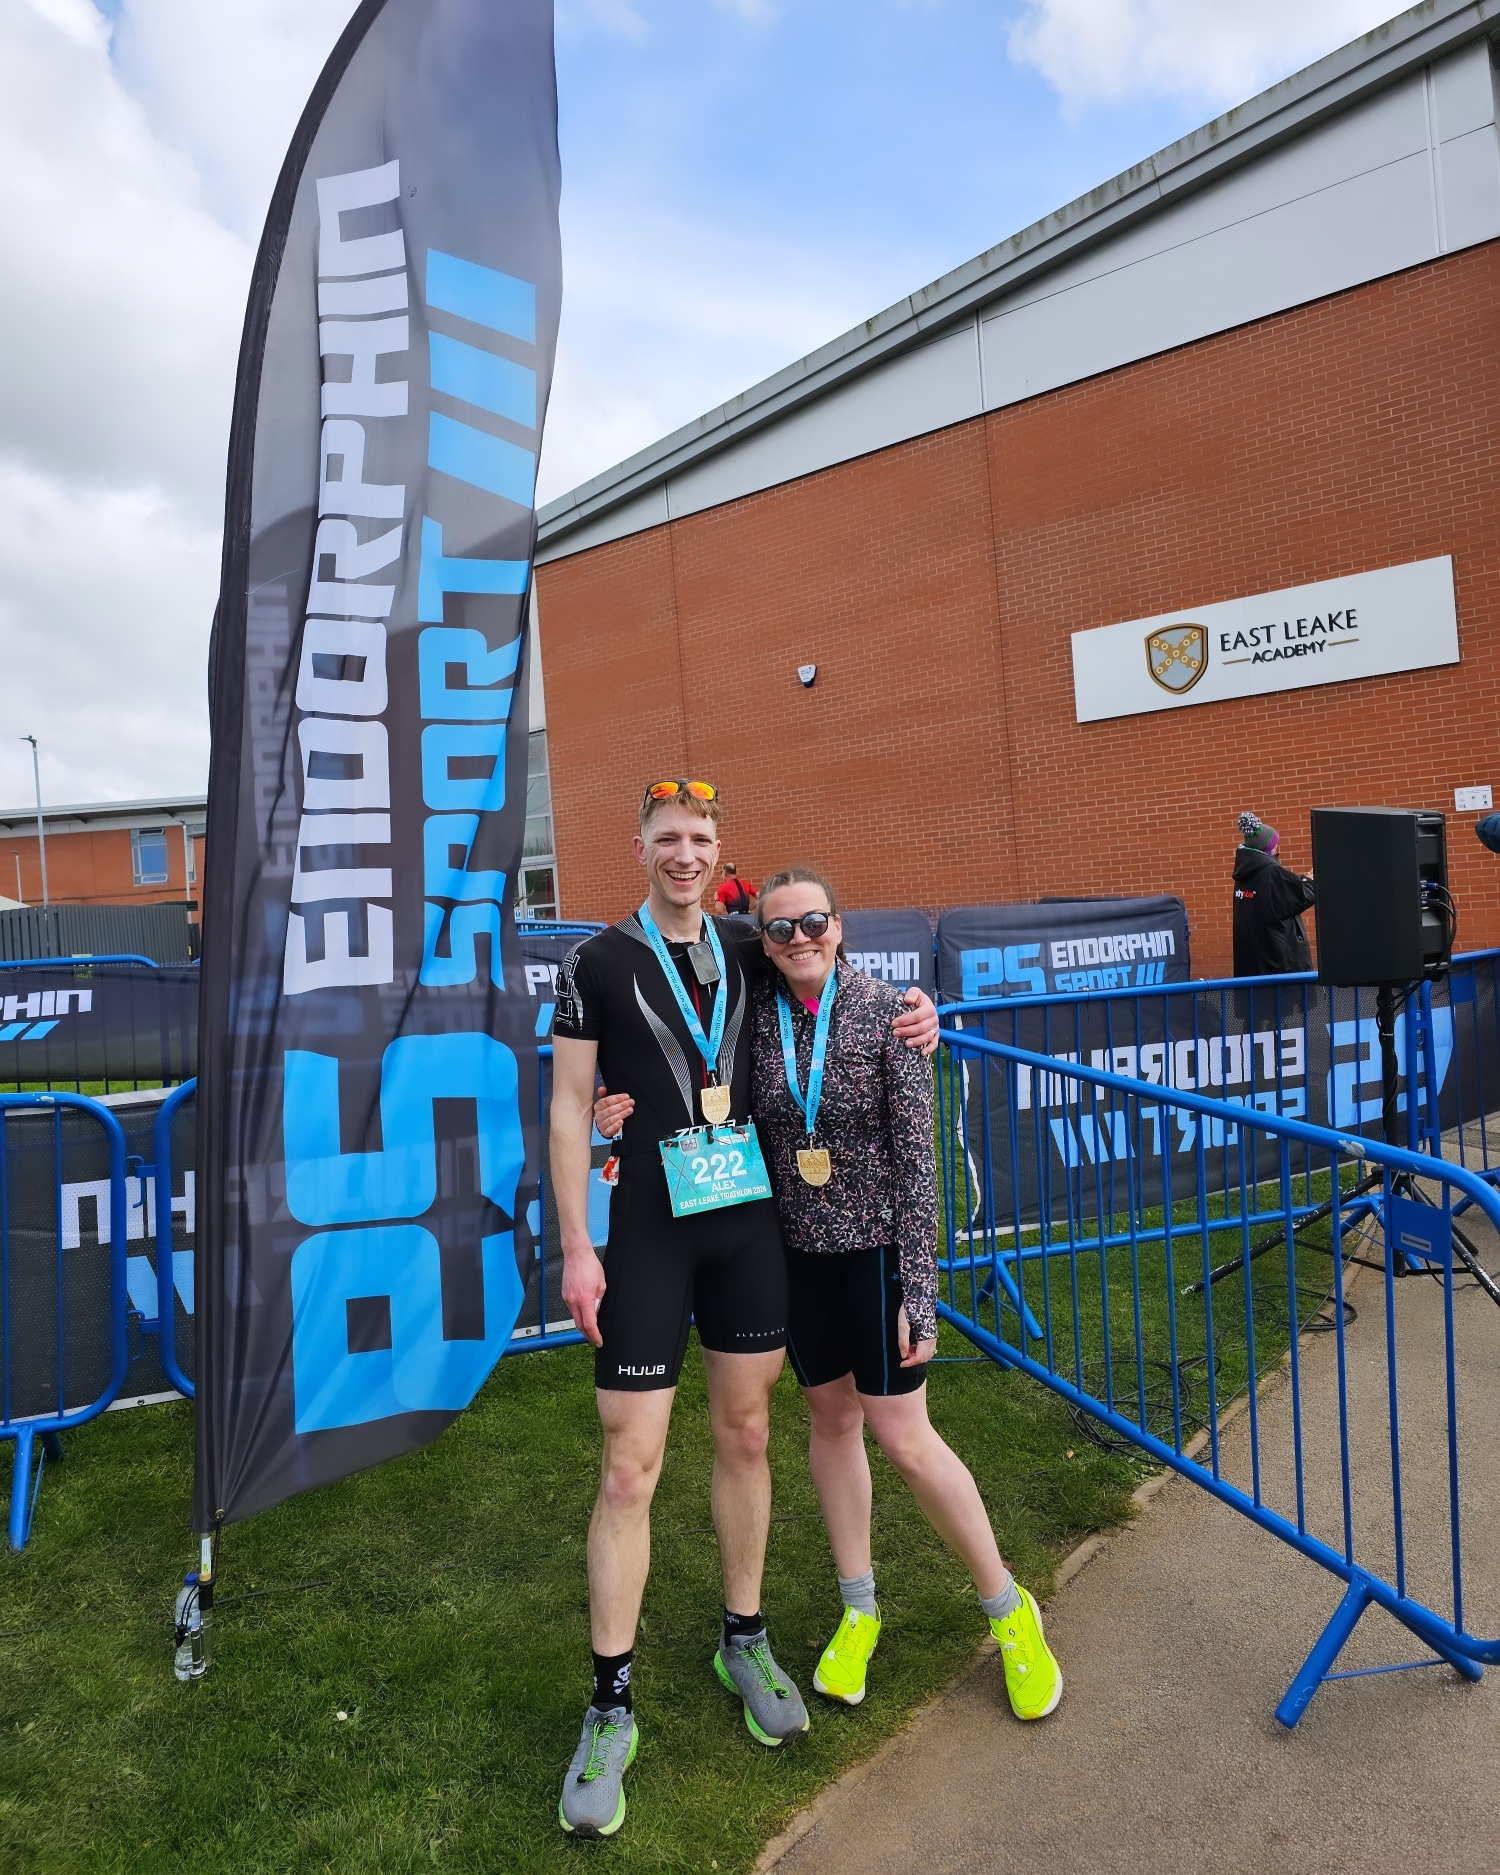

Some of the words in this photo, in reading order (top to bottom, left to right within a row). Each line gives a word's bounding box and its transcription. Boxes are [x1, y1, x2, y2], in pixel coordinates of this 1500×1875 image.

[283, 159, 409, 995] ENDORPHIN
[1220, 624, 1276, 651] EAST
[1284, 608, 1358, 640] LEAKE
[1251, 639, 1326, 664] ACADEMY
[417, 514, 529, 992] SPORT
[1051, 930, 1175, 969] ENDORPHIN
[1054, 965, 1132, 993] SPORT
[691, 1150, 748, 1185] 222
[679, 1198, 697, 1210] EAST
[700, 1194, 719, 1205] LEAKE
[720, 1188, 753, 1201] TRIATHLON
[753, 1184, 767, 1195] 2024
[711, 1179, 736, 1192] ALEX
[618, 1364, 666, 1376] HUUB
